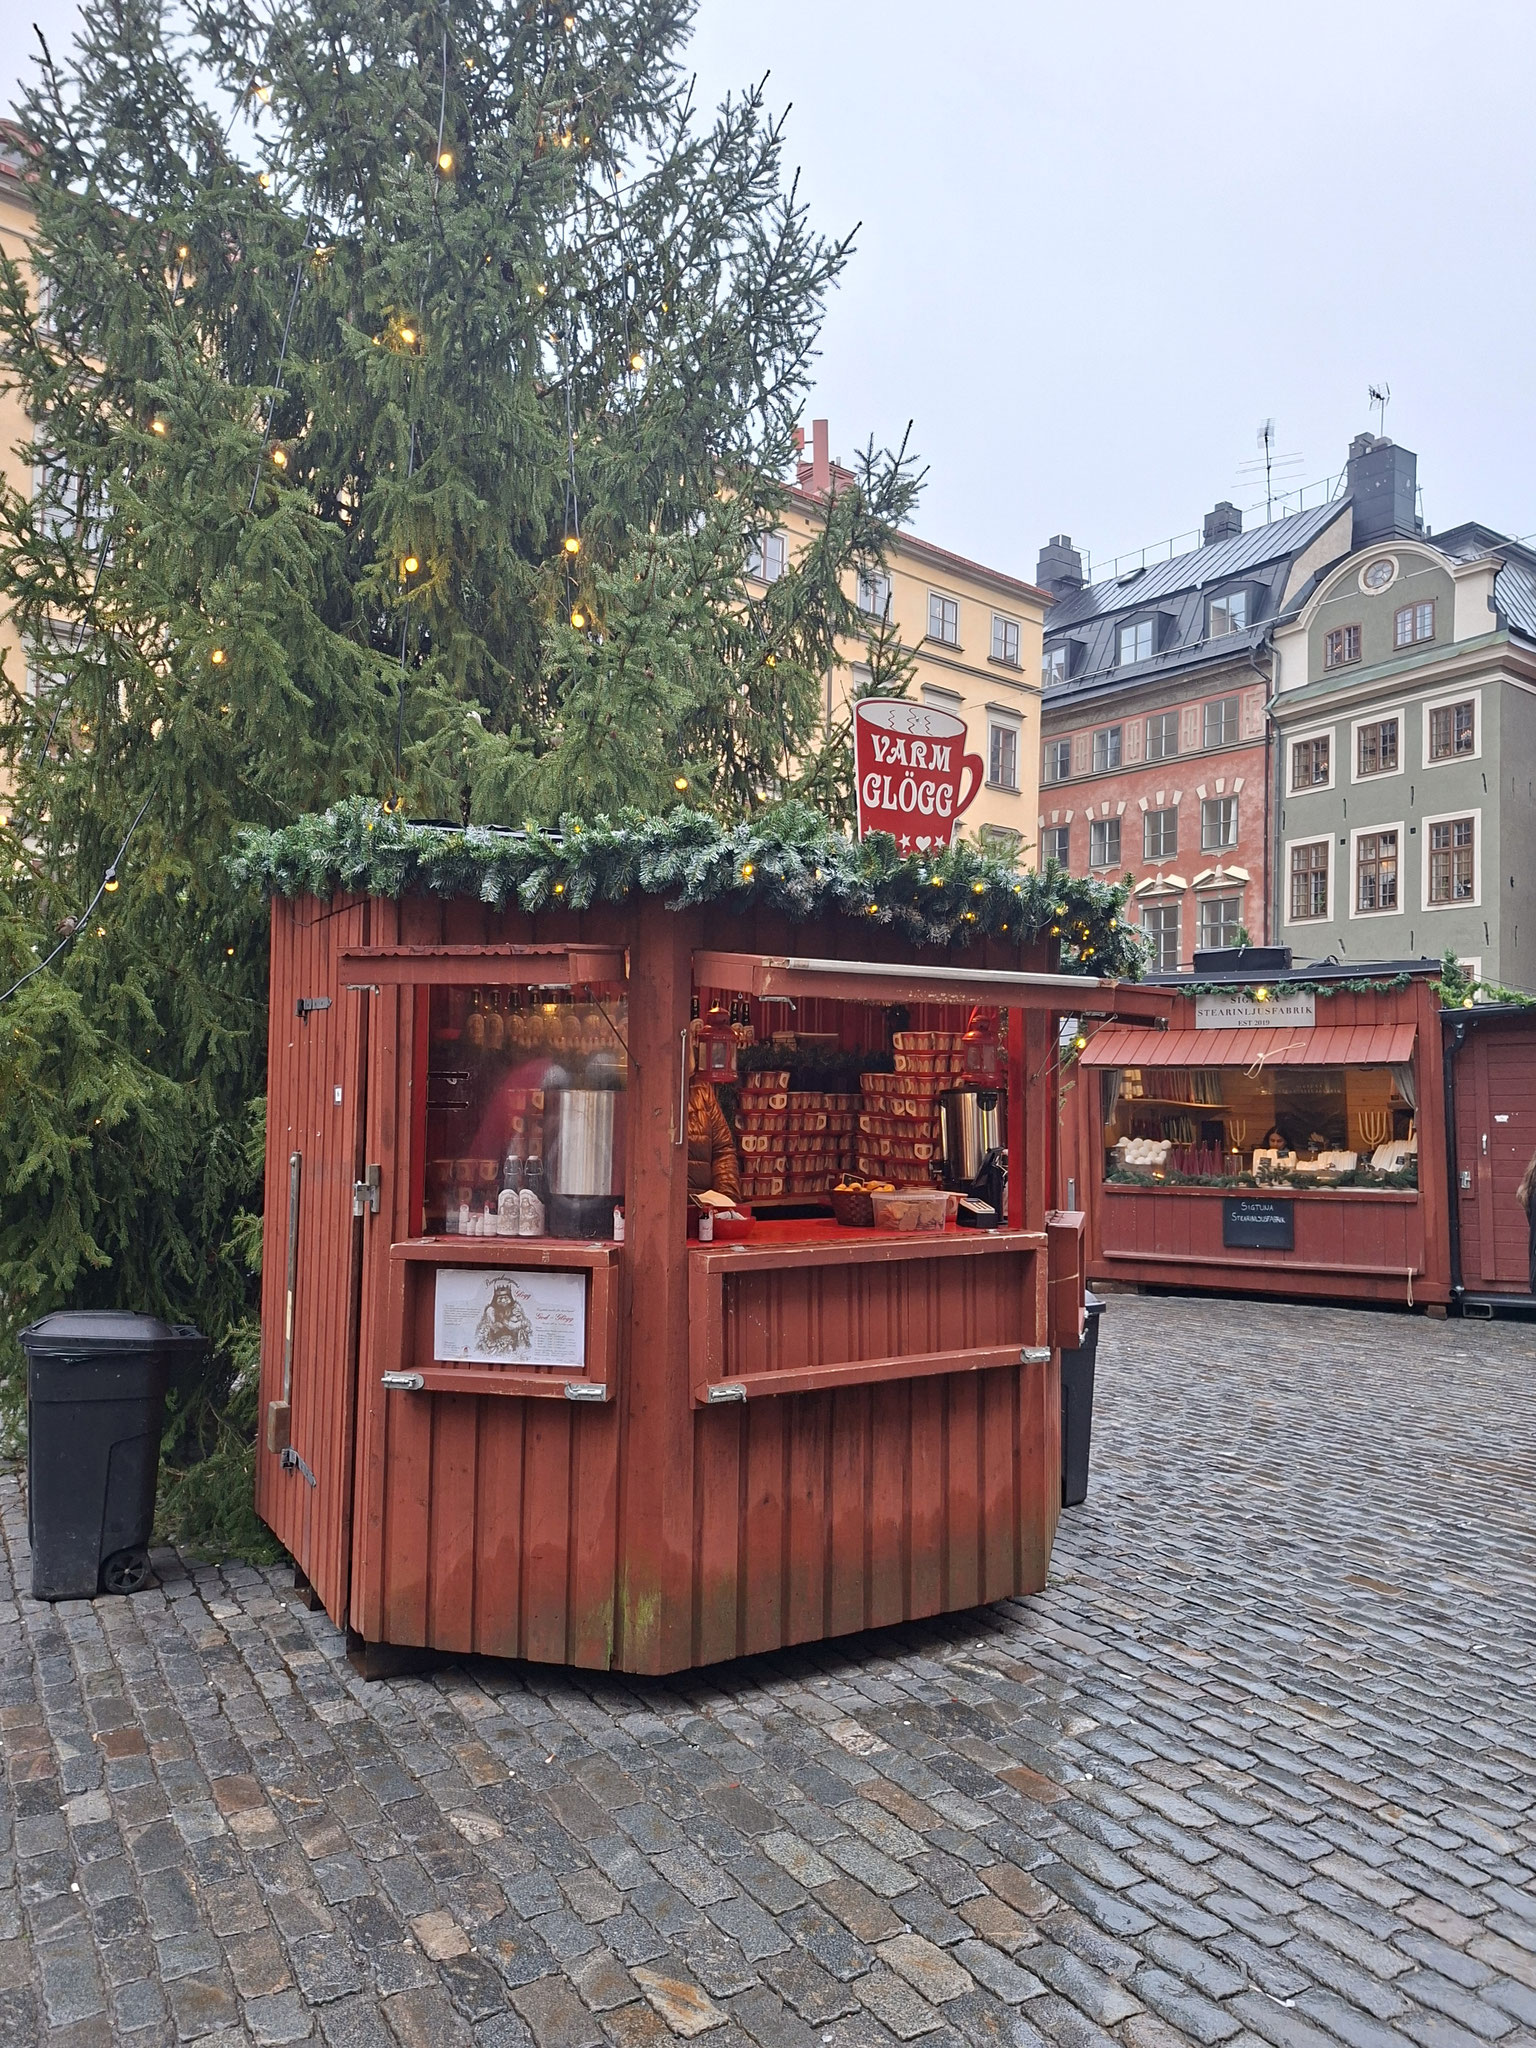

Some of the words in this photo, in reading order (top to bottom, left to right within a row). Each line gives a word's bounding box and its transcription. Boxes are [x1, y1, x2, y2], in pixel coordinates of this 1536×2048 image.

[870, 733, 952, 772] VARM
[862, 770, 954, 818] GLÖGG
[1197, 1006, 1313, 1017] STEARINLJUSFABRIK
[1241, 1201, 1274, 1211] SIGTUNA
